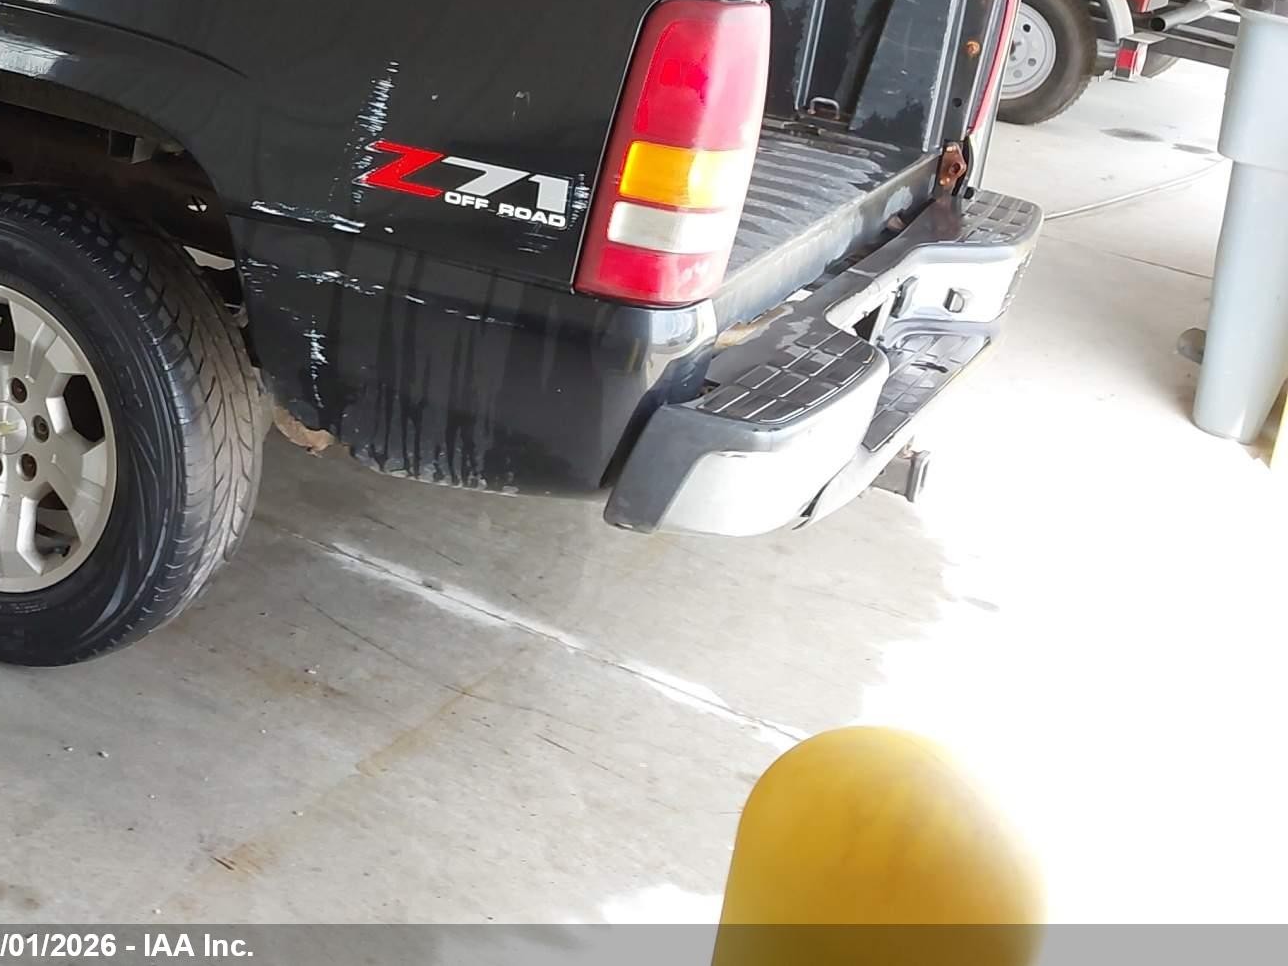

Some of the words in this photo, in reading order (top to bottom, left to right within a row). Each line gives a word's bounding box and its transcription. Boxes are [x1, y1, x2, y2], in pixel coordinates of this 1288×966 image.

[353, 140, 571, 214] Z71
[444, 191, 490, 210] OFF
[496, 202, 567, 229] ROAD
